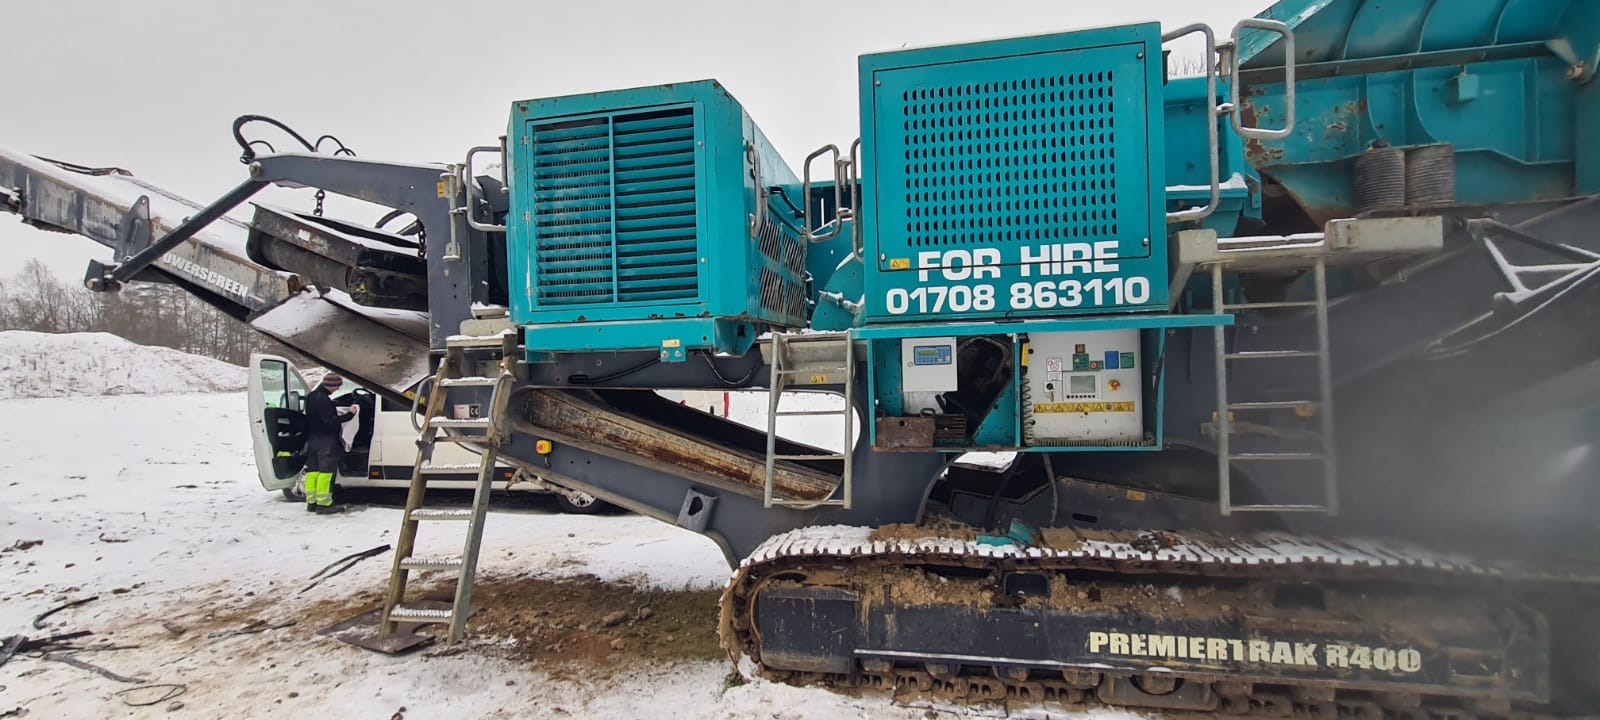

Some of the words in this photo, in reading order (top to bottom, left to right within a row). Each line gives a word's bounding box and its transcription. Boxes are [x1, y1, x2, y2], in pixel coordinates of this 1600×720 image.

[162, 252, 249, 298] OWERSCREEN
[918, 248, 1001, 282] FOR
[1020, 240, 1120, 277] HIRE
[886, 284, 995, 314] 01708
[1009, 276, 1150, 309] 863110
[1089, 631, 1319, 666] PREMIERTRAK
[1325, 644, 1422, 673] R400
